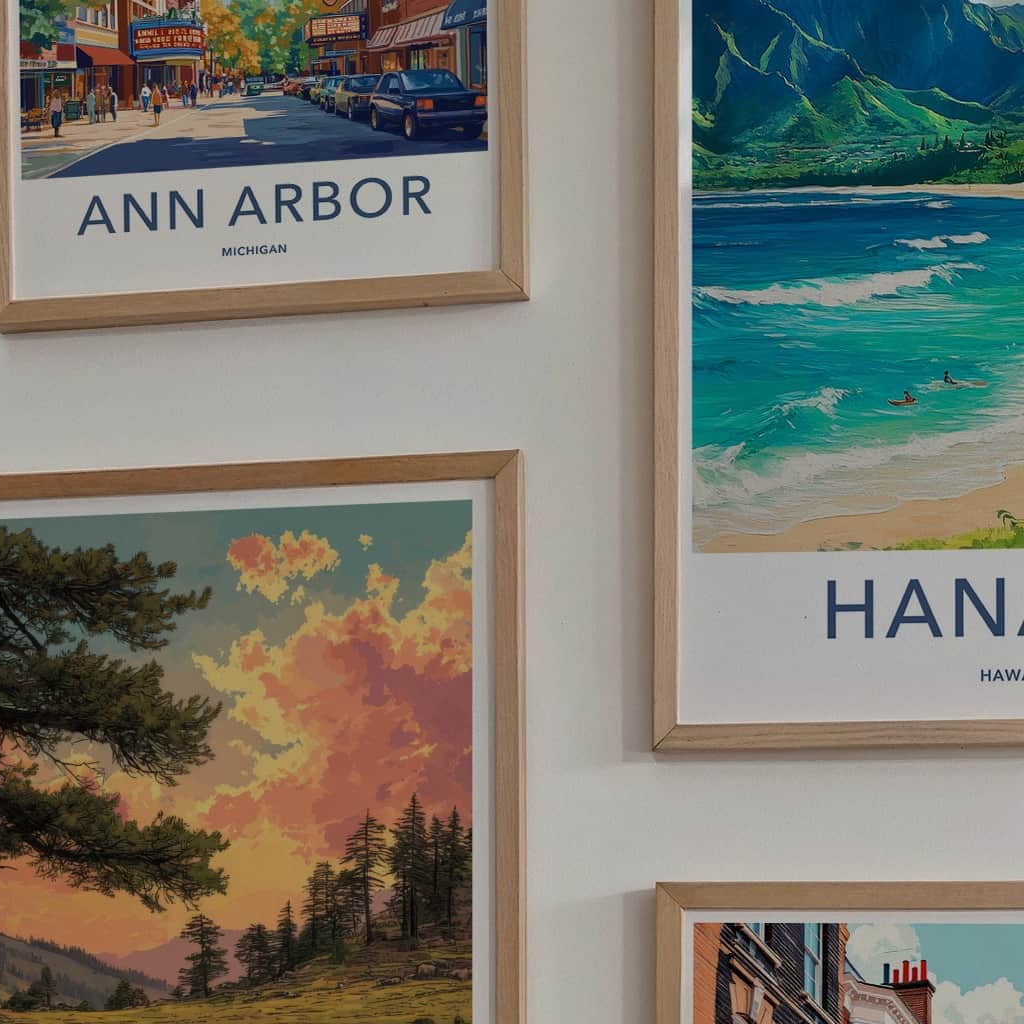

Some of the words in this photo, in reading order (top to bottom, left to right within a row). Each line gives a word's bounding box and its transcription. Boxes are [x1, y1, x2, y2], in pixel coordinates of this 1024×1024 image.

[77, 188, 205, 236] ANN
[228, 174, 432, 227] ARBOR
[221, 243, 288, 257] MICHIGAN
[826, 577, 1024, 639] HAN
[980, 668, 1024, 682] HAW
